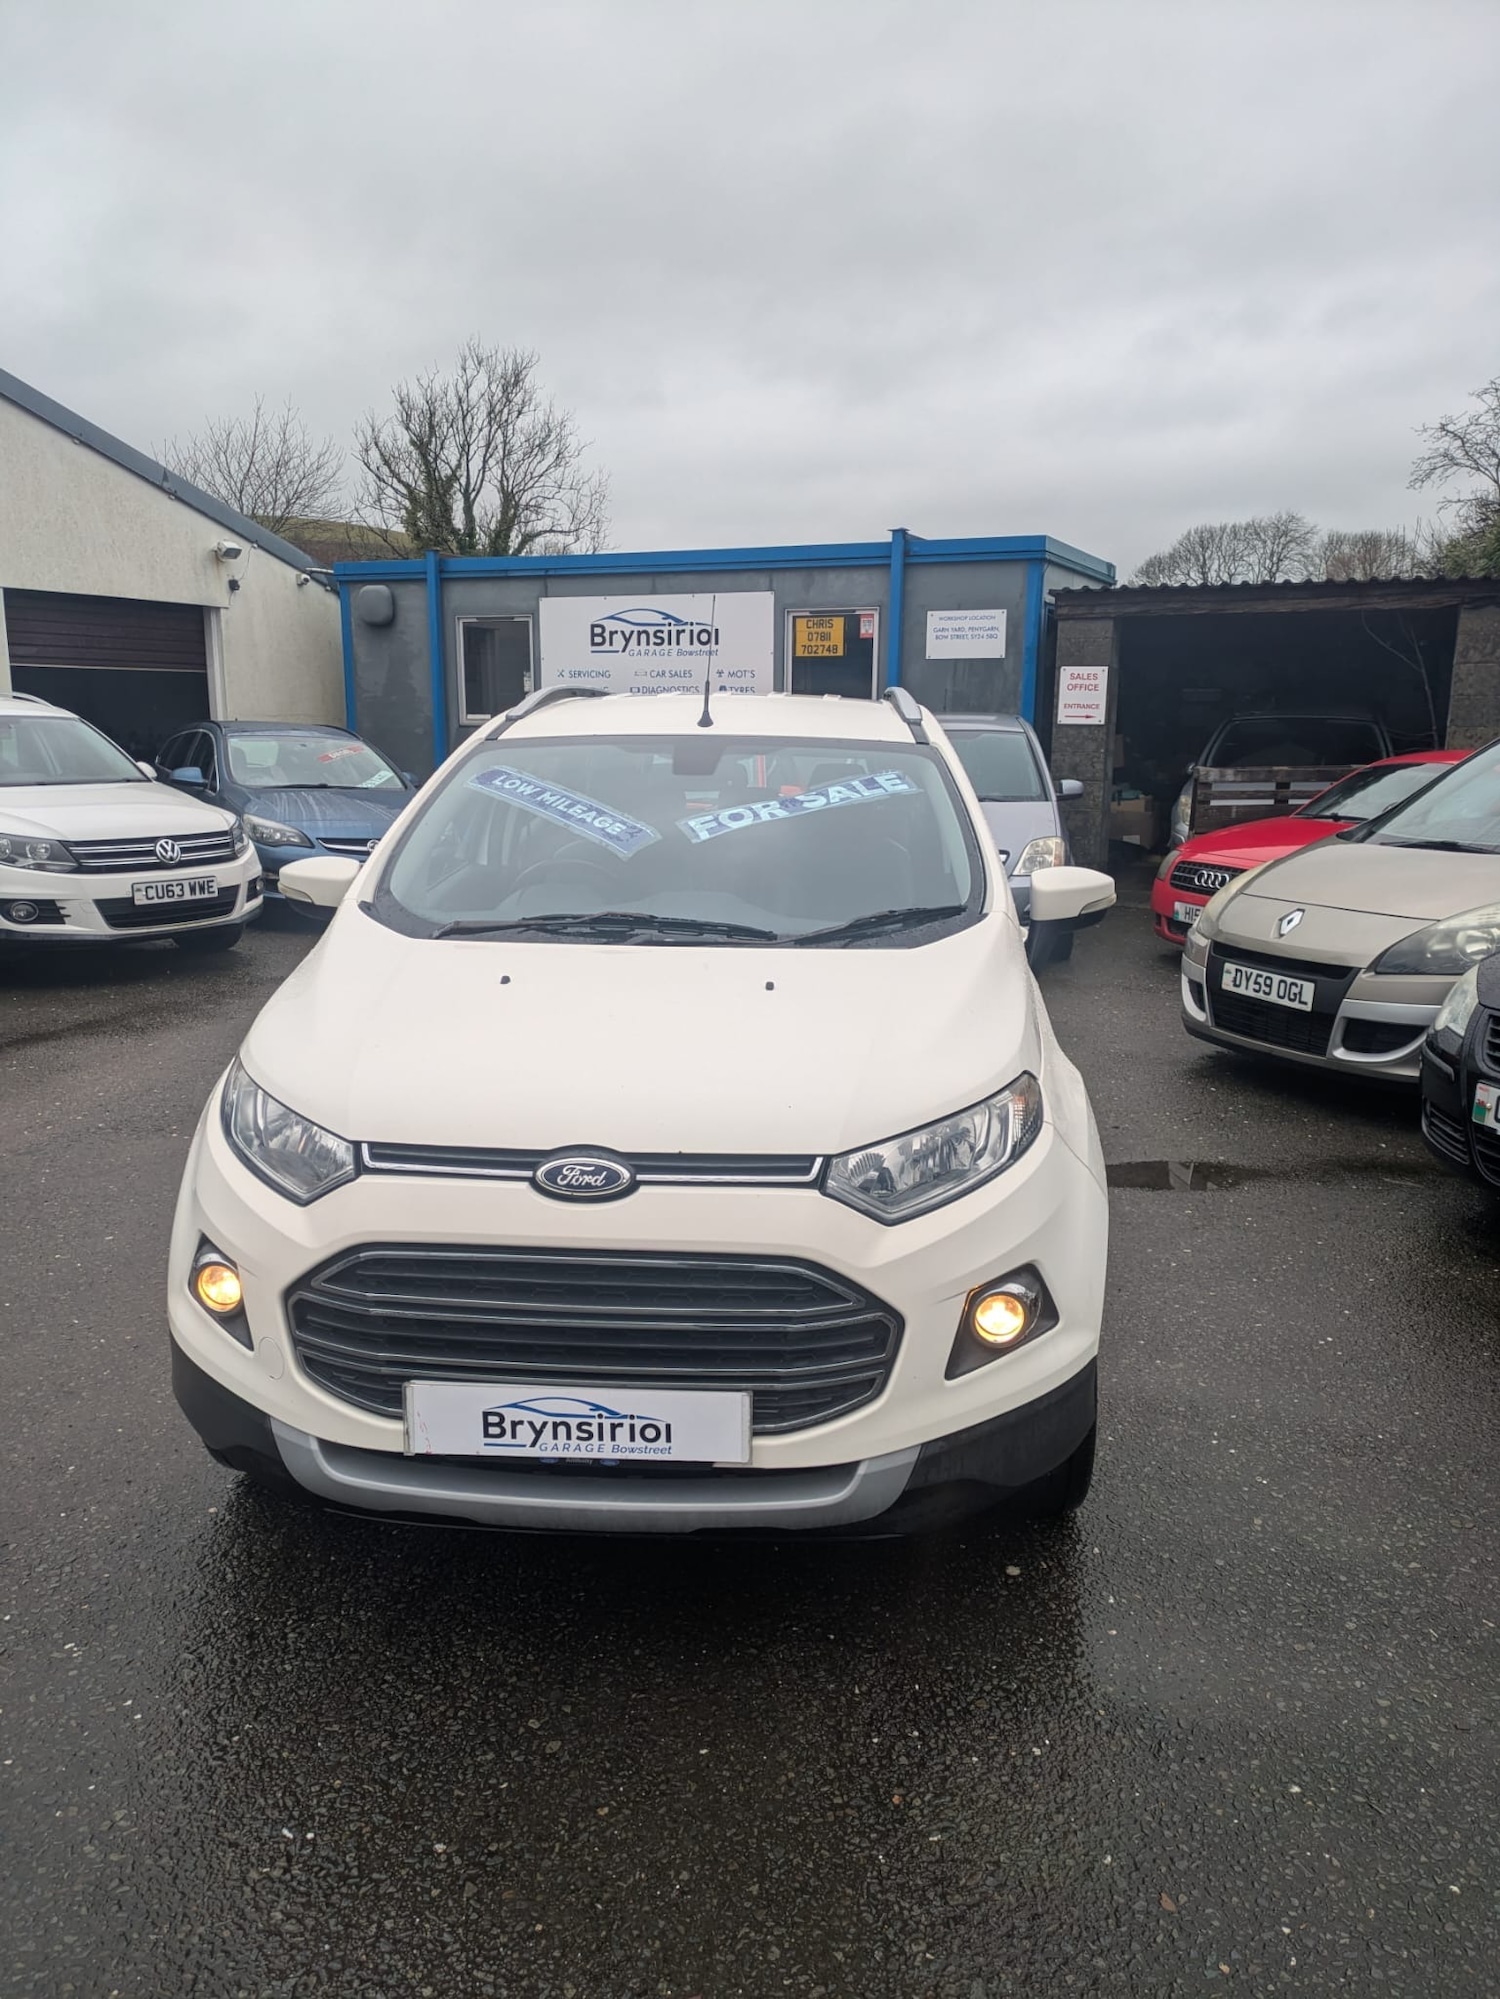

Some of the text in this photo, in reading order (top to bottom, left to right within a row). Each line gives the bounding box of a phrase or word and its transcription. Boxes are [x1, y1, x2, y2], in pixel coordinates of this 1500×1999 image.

[806, 619, 834, 629] CHRIS
[590, 622, 719, 653] Brynsiriol
[807, 631, 831, 642] 07811
[628, 648, 719, 657] GARAGE Bowstreet
[801, 644, 838, 655] 702748
[568, 669, 611, 679] SERVICING
[650, 669, 693, 678] CAR SALES
[727, 670, 756, 679] MOT'S
[1070, 672, 1099, 681] SALES
[641, 685, 700, 695] DIAGNOSTICS
[1066, 683, 1100, 692] OFFICE
[491, 774, 627, 835] LOW MILEAGE
[688, 773, 910, 840] FOR SALE
[145, 879, 216, 901] CU63 WWE
[1231, 967, 1309, 1006] DY59 OGL
[556, 1163, 606, 1187] Ford
[481, 1411, 673, 1448] Brynsiriol
[539, 1442, 673, 1455] GARAGE Bowstreet
